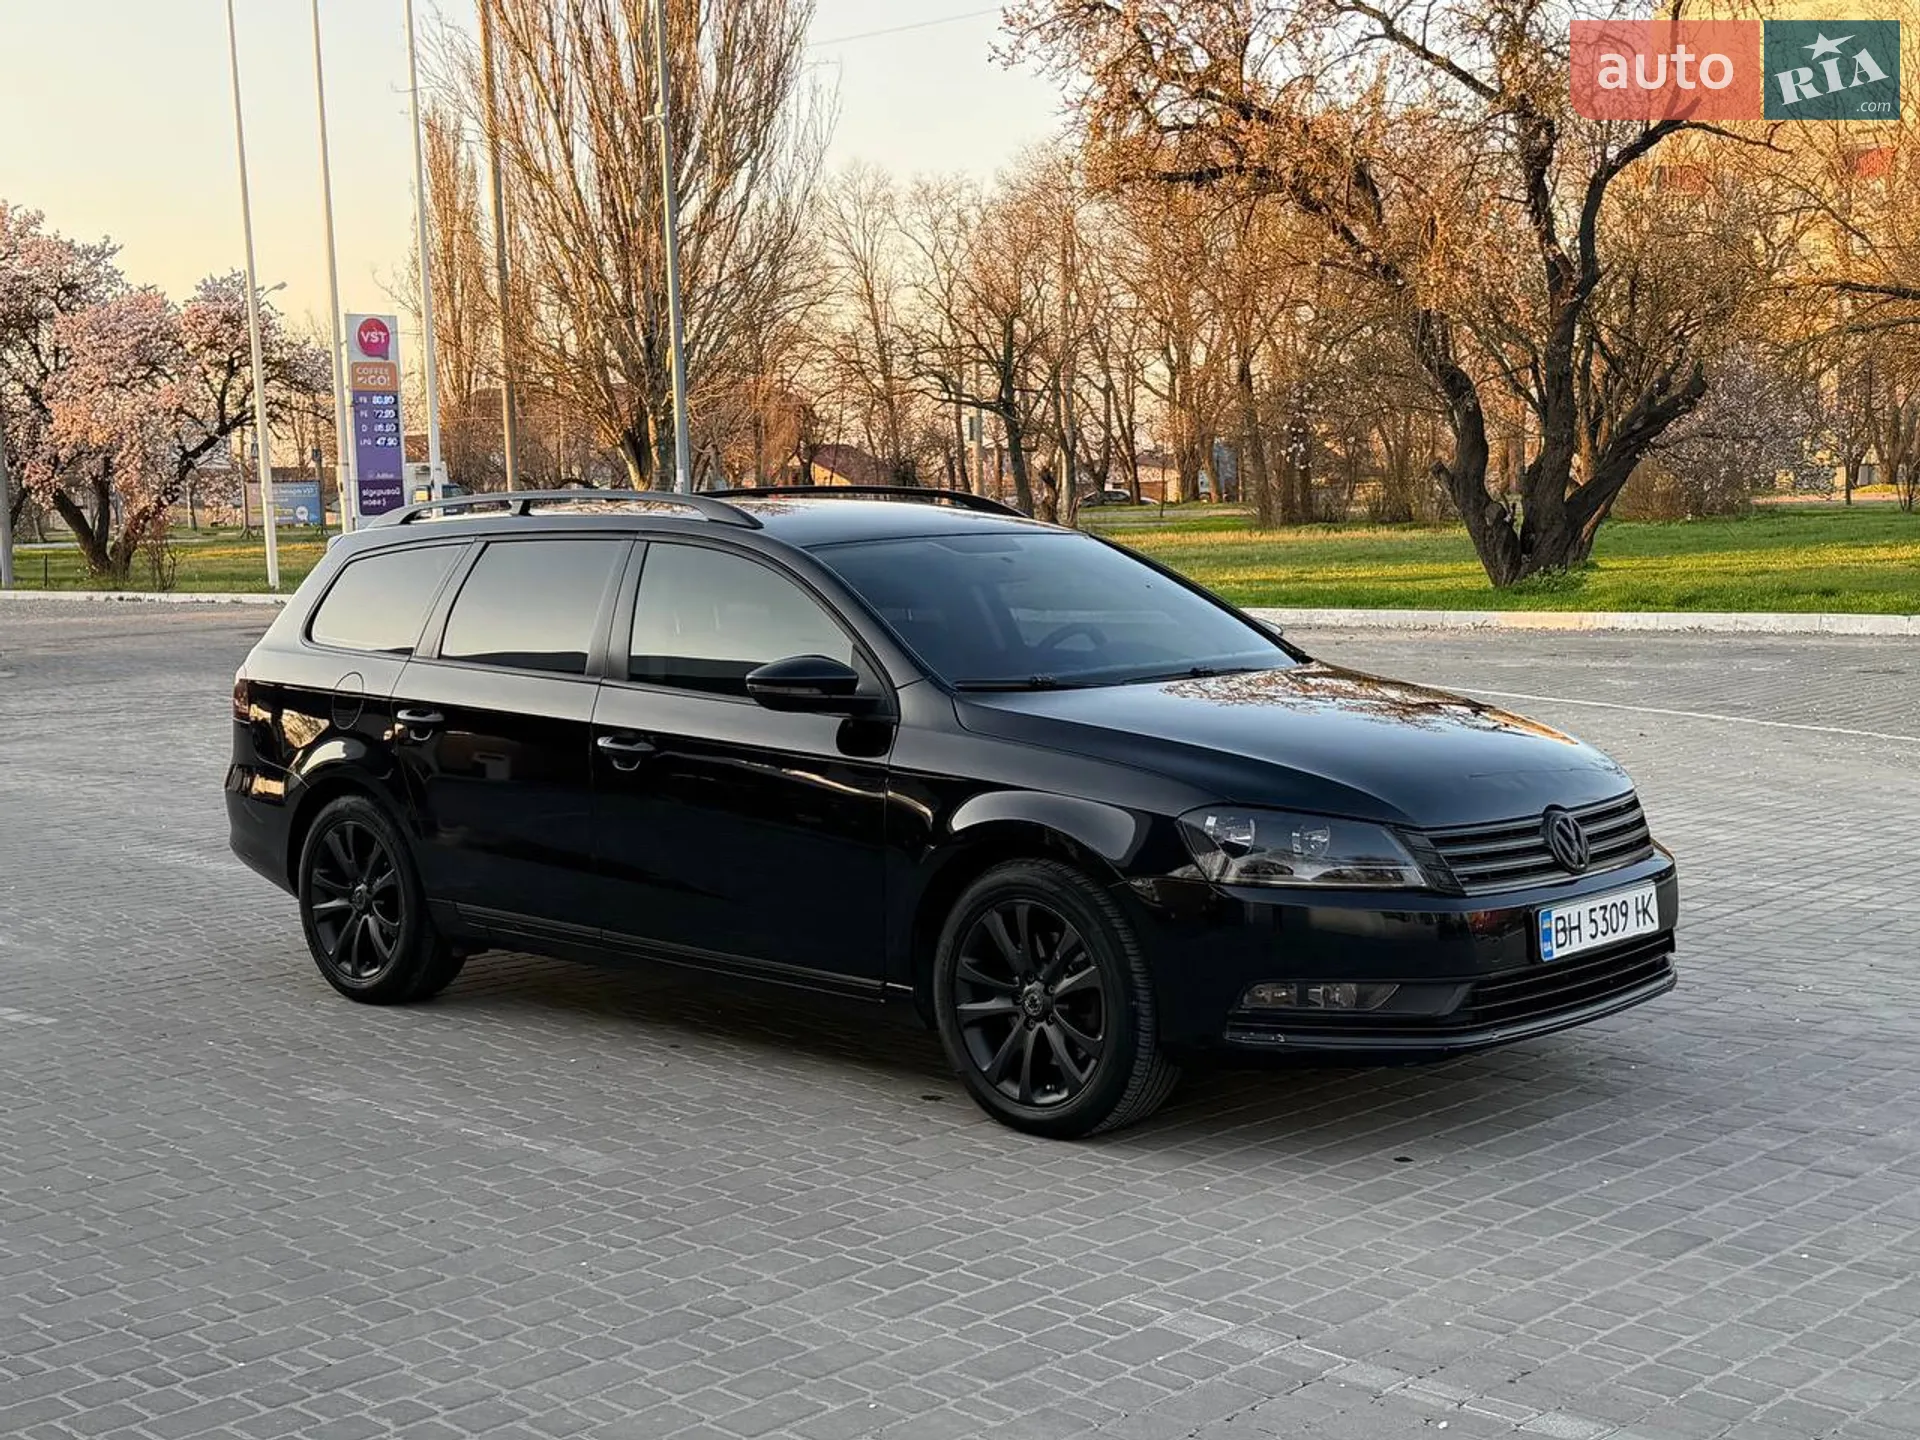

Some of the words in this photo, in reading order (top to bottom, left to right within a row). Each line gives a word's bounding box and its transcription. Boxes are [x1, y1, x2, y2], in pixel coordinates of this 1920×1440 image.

[360, 331, 387, 344] VST
[356, 367, 389, 375] COFFEE
[1555, 911, 1582, 949] BH
[1589, 899, 1629, 939] 5309
